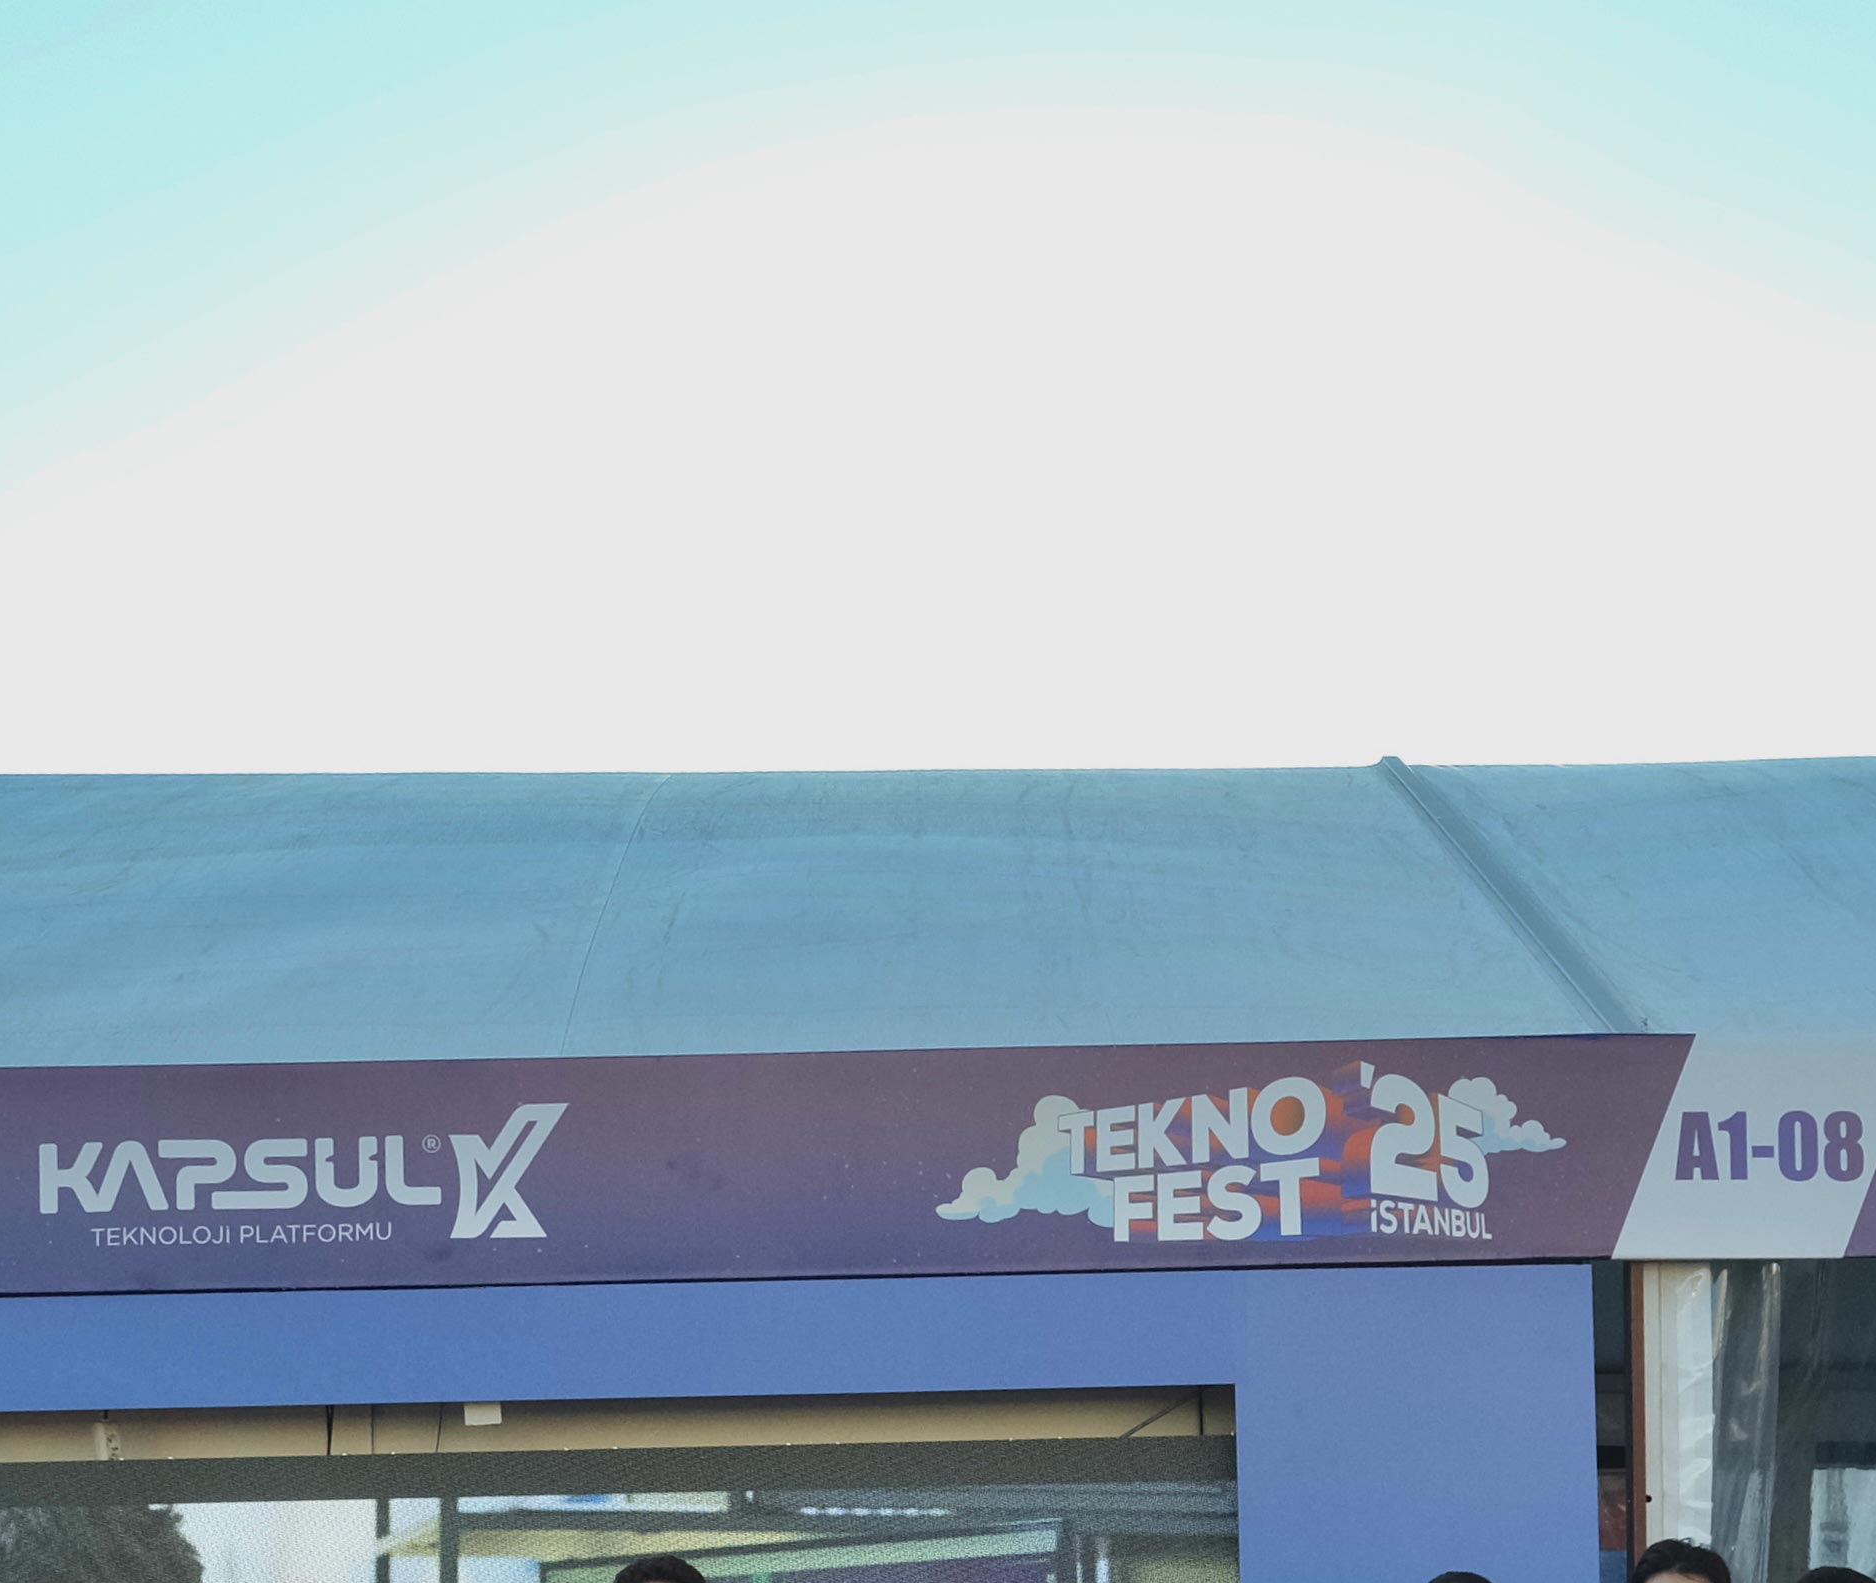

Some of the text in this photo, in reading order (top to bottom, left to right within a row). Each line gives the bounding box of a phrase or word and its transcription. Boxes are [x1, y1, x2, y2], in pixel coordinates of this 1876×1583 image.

[1057, 1077, 1327, 1175] TEKNO
[1676, 1111, 1865, 1181] A1-08
[239, 1221, 393, 1244] PLATFORMU
[1113, 1157, 1321, 1242] FEST
